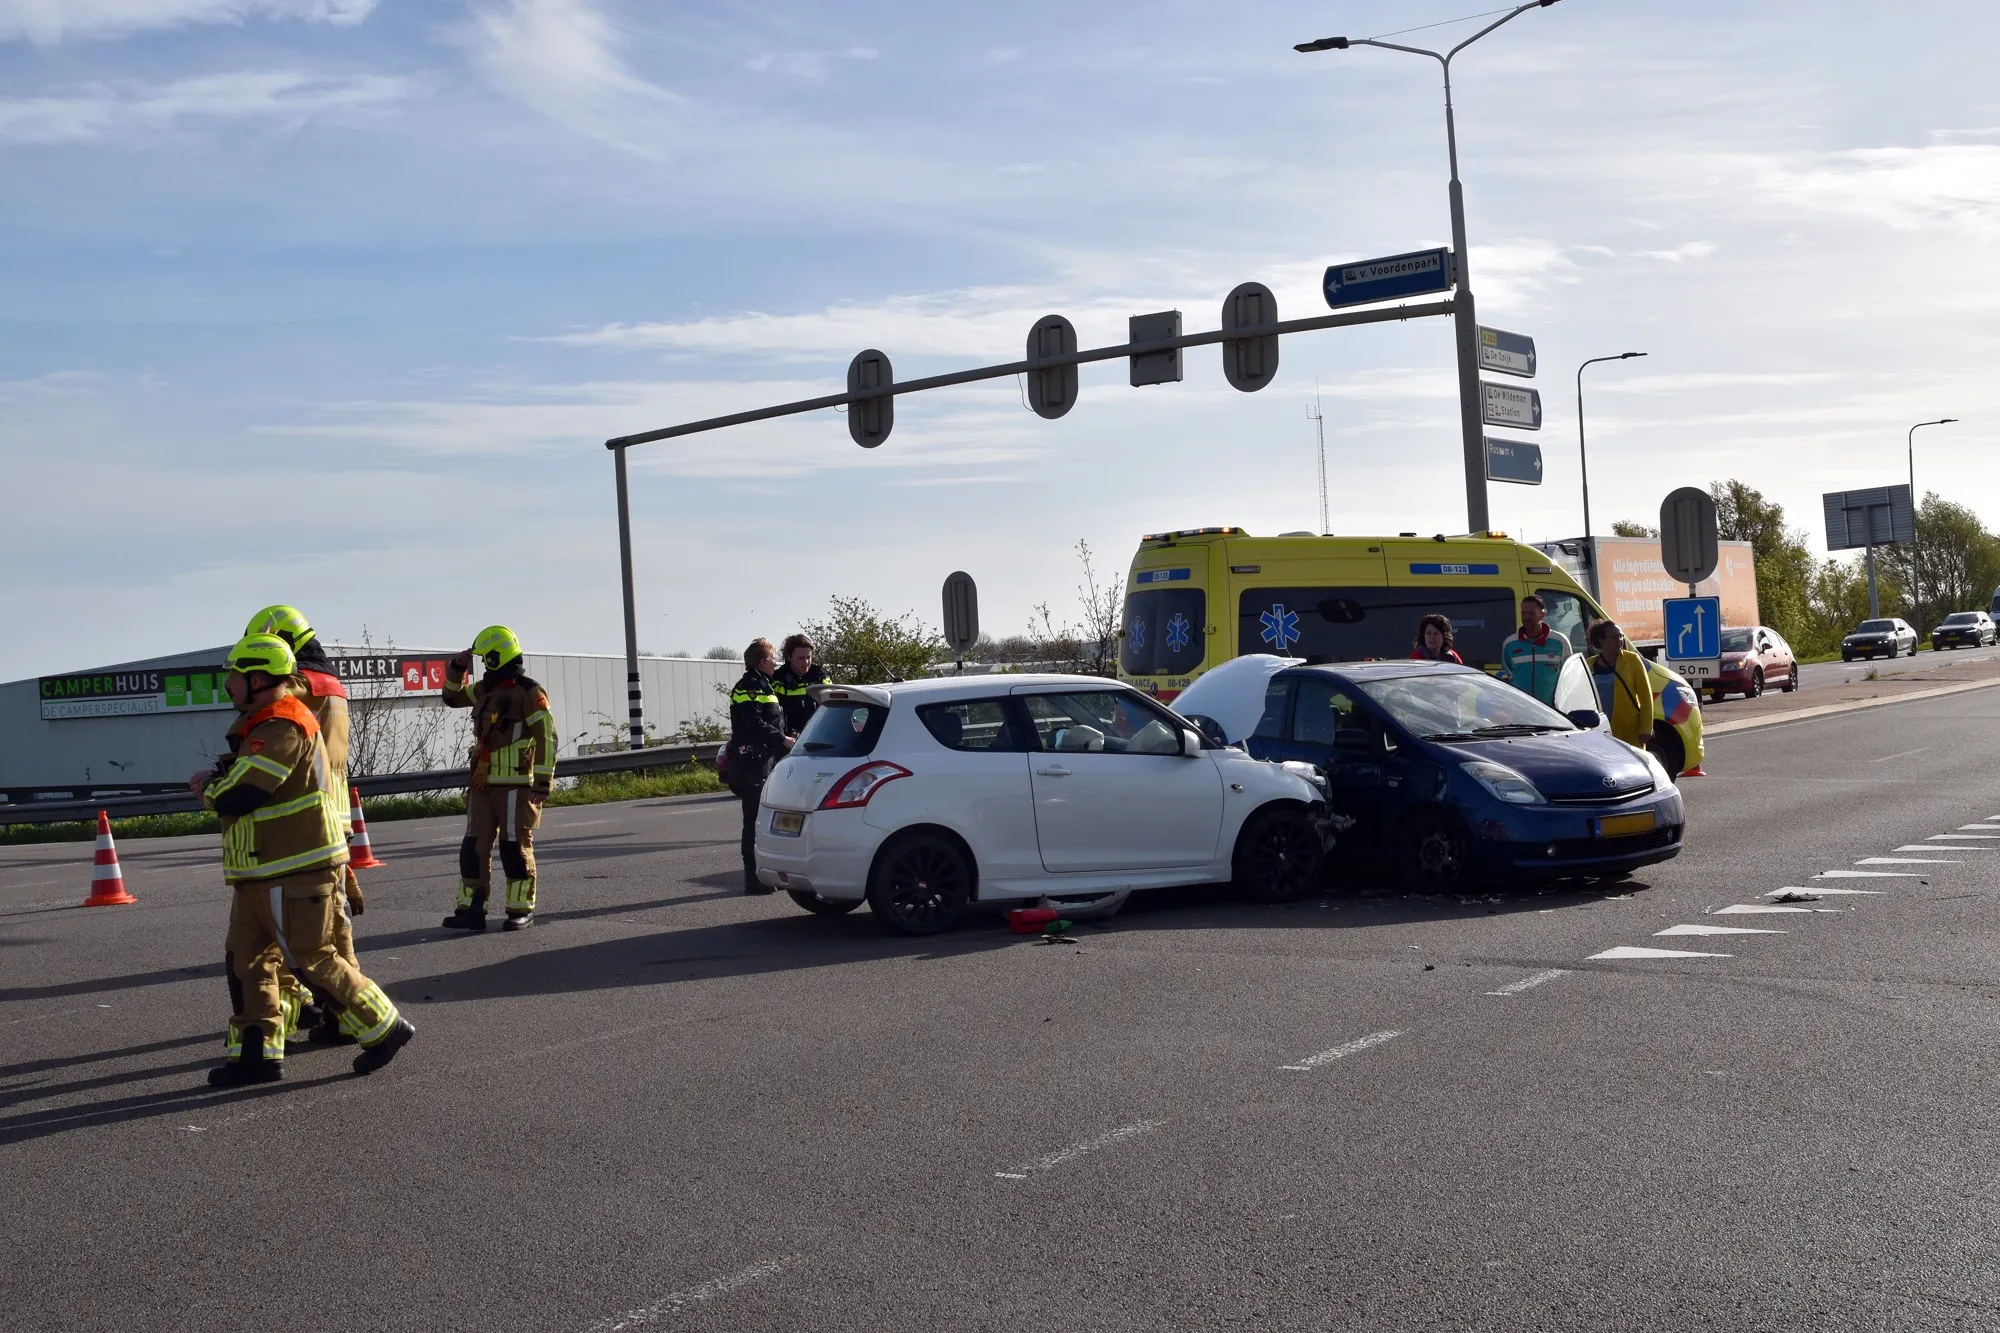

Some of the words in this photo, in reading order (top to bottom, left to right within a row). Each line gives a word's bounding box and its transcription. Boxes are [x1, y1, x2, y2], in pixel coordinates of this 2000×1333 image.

[1360, 270, 1368, 278] v.
[1370, 257, 1439, 277] Voordenpark
[1490, 350, 1498, 360] De
[1494, 389, 1501, 399] De
[1502, 391, 1527, 403] Wildeman
[1501, 406, 1521, 417] Station
[1443, 565, 1468, 573] 08-128
[1613, 559, 1626, 573] Alle
[1626, 559, 1665, 576] ingrediënte
[1154, 571, 1168, 580] 08-128
[1679, 665, 1696, 675] 50
[1699, 667, 1709, 675] m
[42, 673, 159, 697] CAMPERHUIS
[43, 707, 56, 717] DE
[59, 701, 159, 716] CAMPERSPECIALIST
